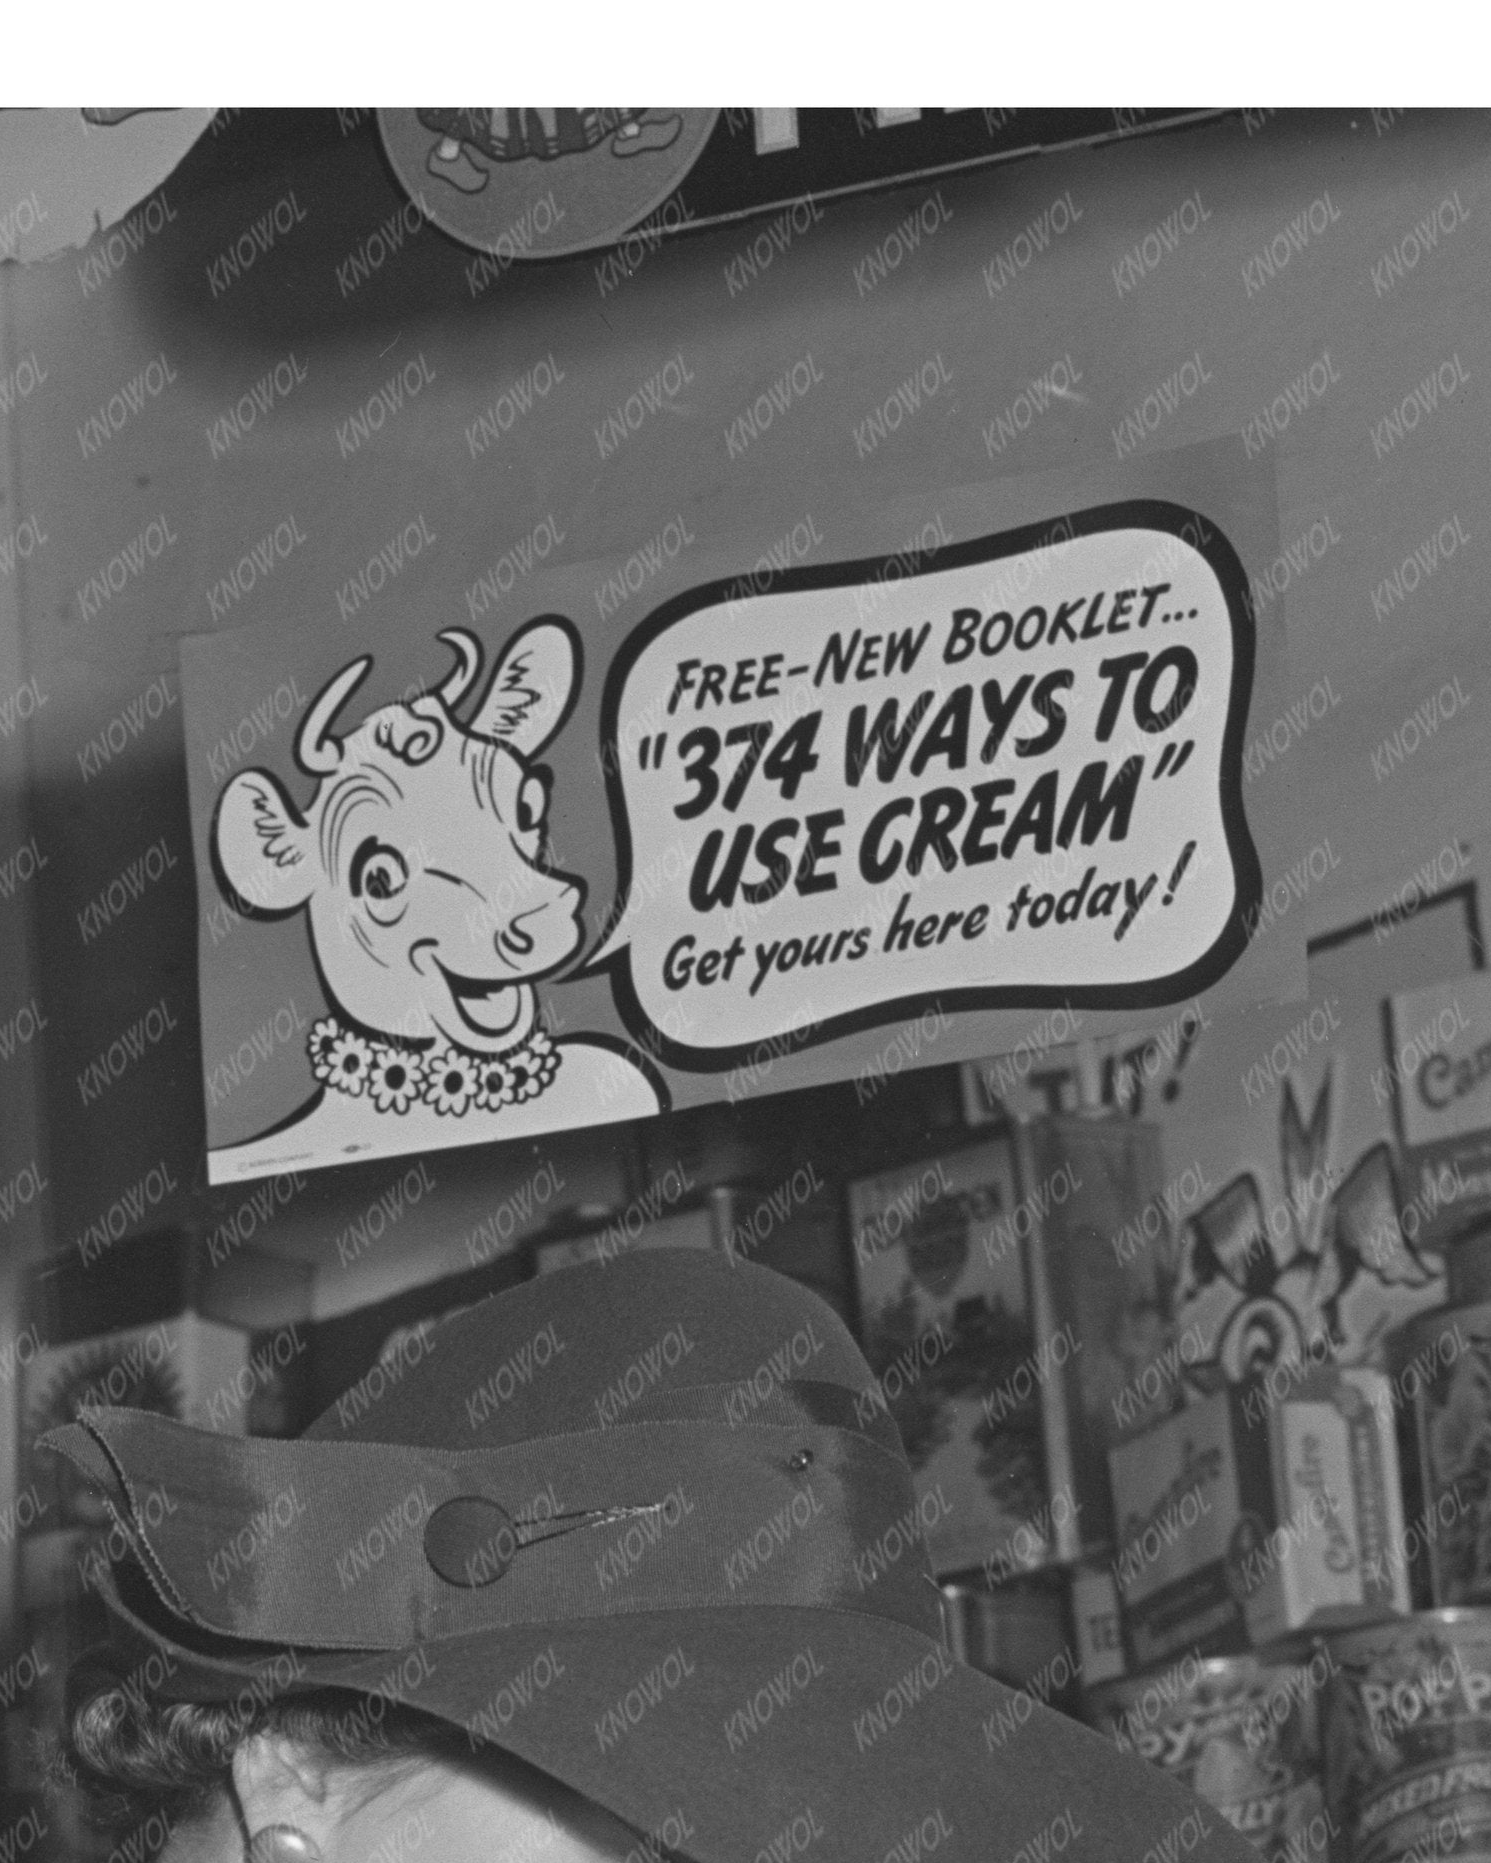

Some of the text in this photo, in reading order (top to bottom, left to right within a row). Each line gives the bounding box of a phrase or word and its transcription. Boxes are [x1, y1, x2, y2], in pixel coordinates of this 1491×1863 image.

[844, 668, 1075, 787] WAYS
[1094, 645, 1199, 743] TO
[662, 839, 1198, 997] Get yours here today!
[688, 808, 846, 913] USE
